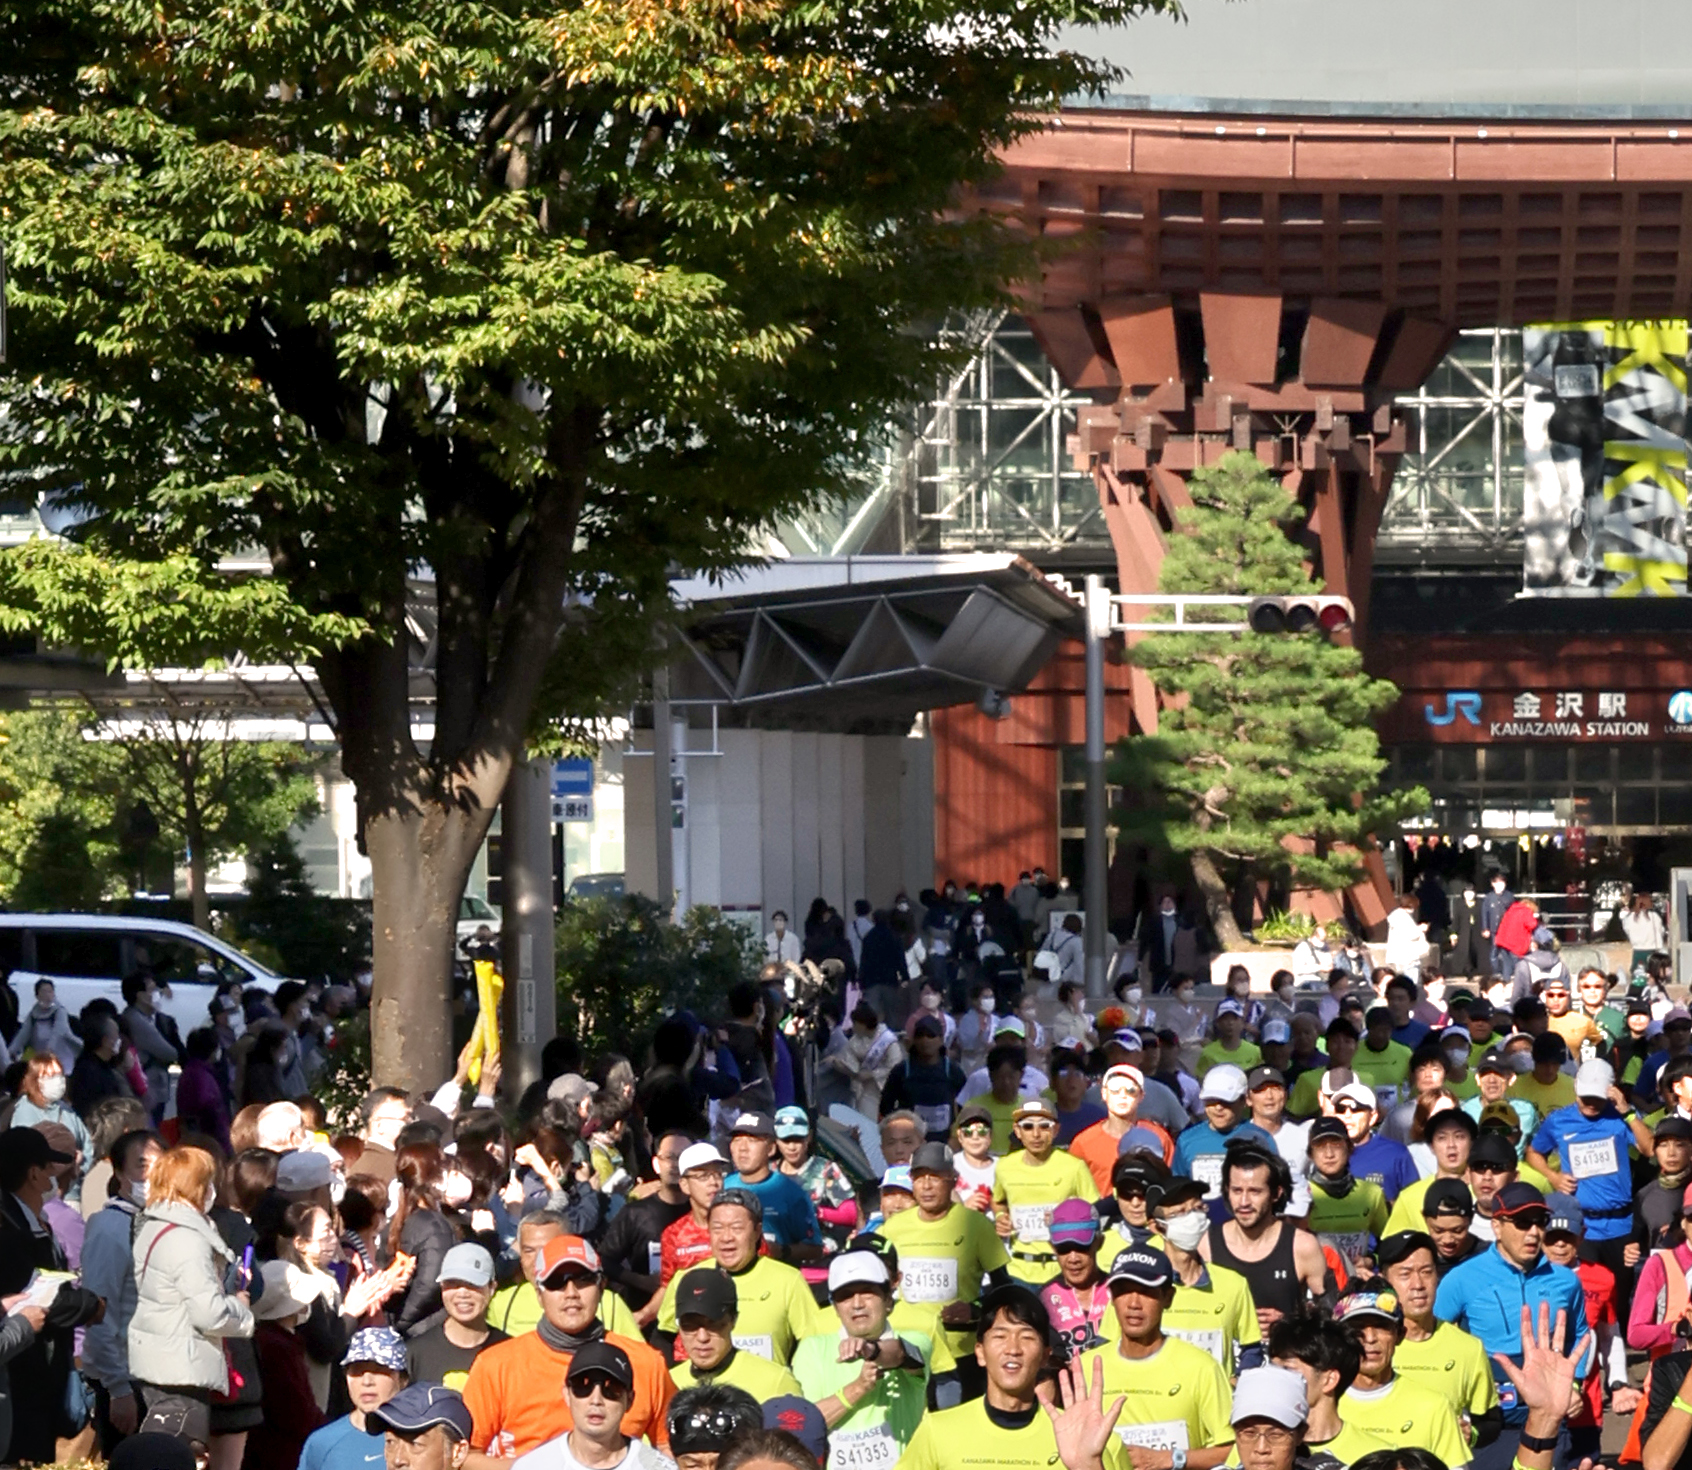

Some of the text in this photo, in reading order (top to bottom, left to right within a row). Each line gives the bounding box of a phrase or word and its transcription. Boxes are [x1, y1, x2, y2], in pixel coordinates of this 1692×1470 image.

[1425, 692, 1482, 725] JR
[1513, 692, 1626, 718] 金沢駅
[1490, 722, 1648, 736] KANAZAWA STATION
[1115, 1253, 1157, 1271] SRIXON
